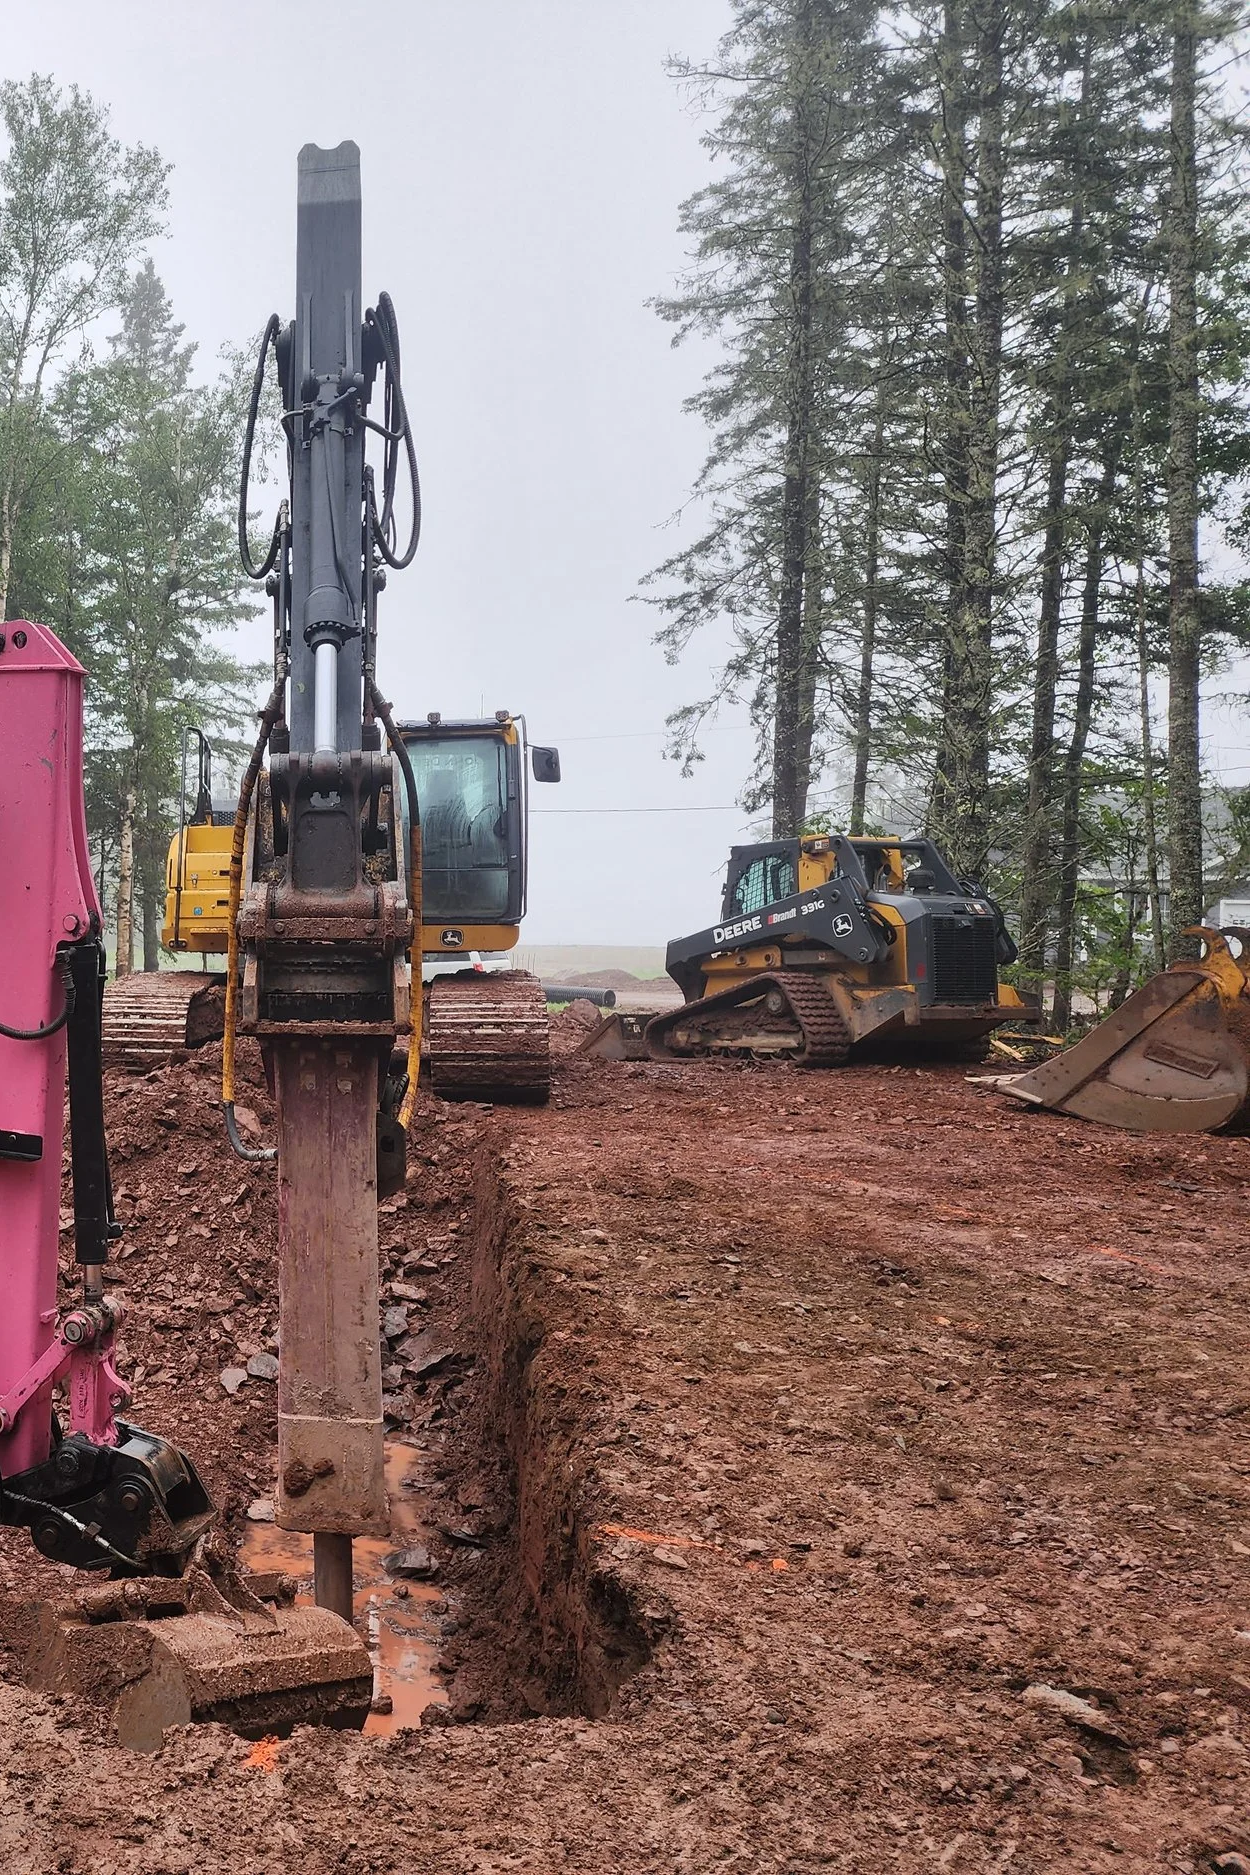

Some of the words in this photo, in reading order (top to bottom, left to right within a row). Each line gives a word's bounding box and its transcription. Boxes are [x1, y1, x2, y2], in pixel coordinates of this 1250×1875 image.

[713, 915, 762, 944] DEERE
[772, 907, 797, 924] Brandt
[801, 899, 825, 915] 331G
